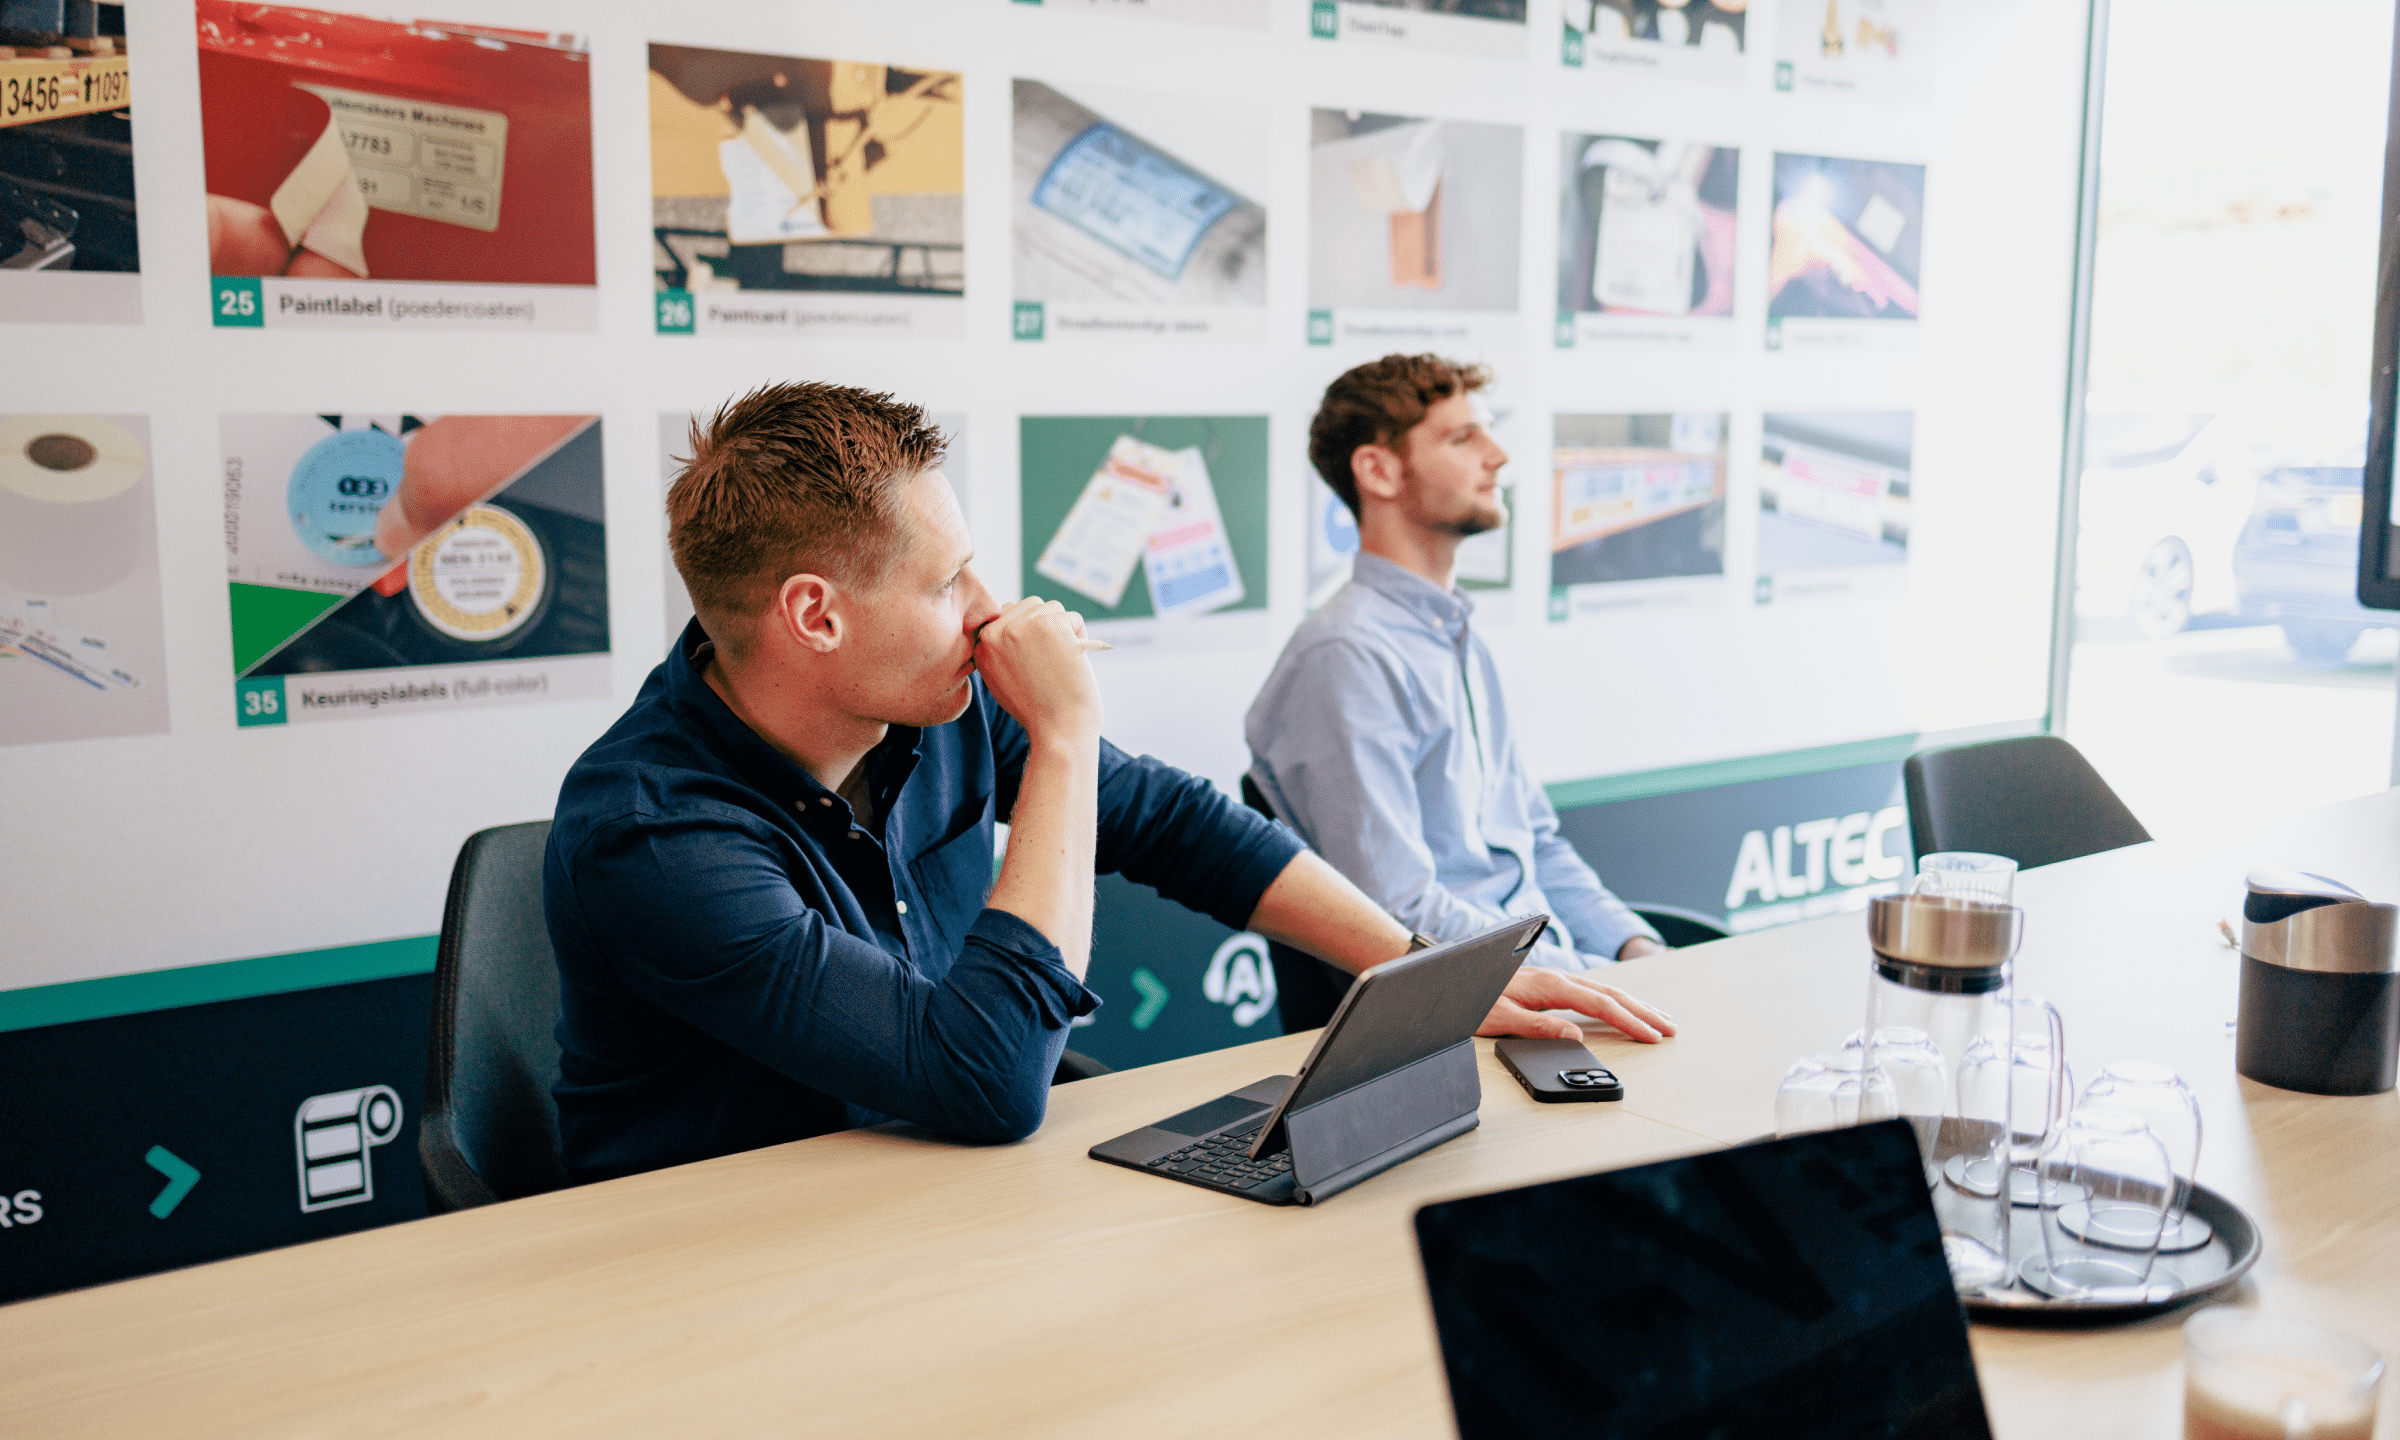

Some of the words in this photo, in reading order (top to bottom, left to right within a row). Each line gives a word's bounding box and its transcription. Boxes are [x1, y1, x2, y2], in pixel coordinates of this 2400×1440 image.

[219, 289, 256, 316] 25
[279, 293, 383, 316] Paintlabel
[388, 299, 536, 322] (poedercoaten)
[660, 300, 692, 327] 26
[244, 689, 279, 716] 35
[301, 682, 447, 710] Keuringslabels
[453, 670, 548, 701] (full-color)
[1724, 805, 1906, 909] ALTEC
